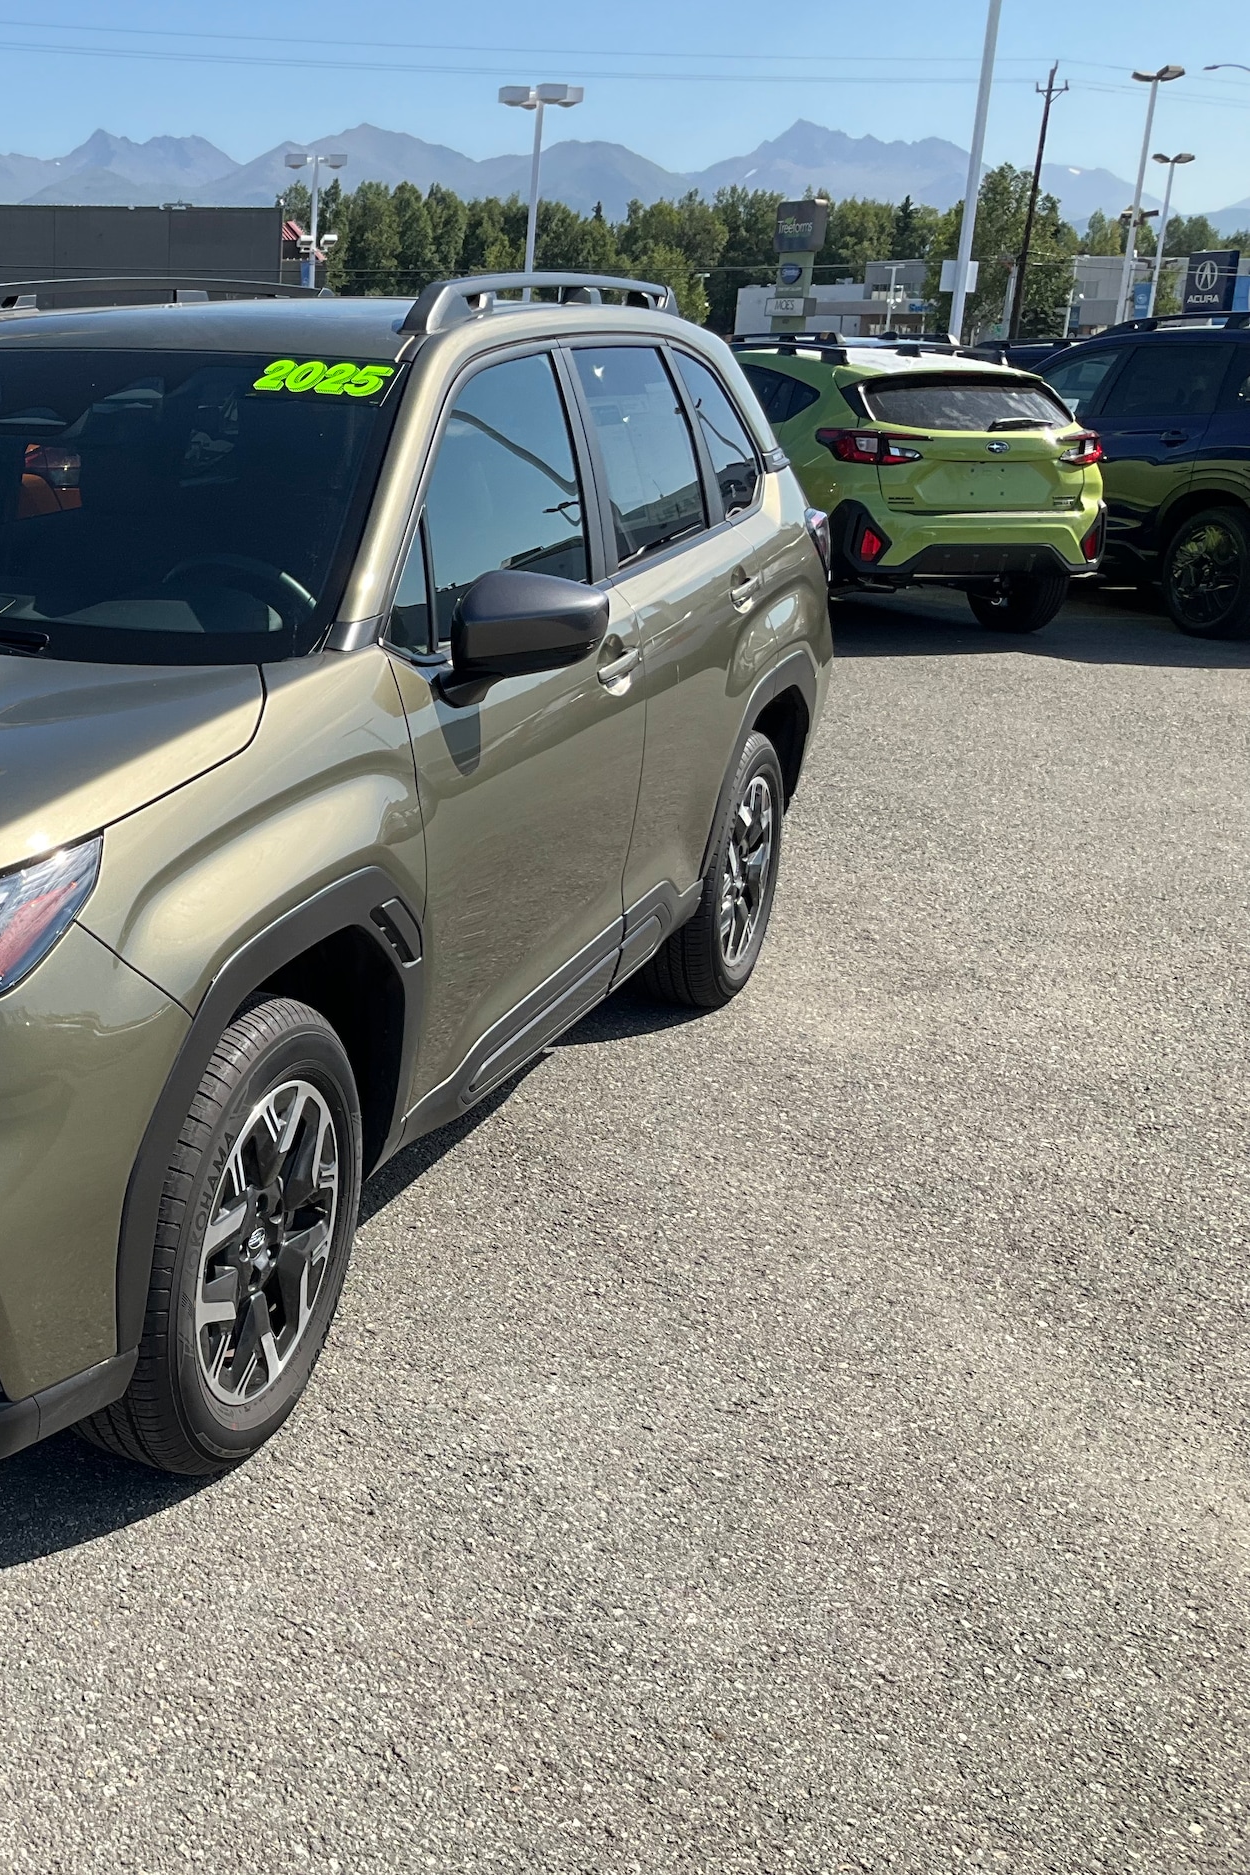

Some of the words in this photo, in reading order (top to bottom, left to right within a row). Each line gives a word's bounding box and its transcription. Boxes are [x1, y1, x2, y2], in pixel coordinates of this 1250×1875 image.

[778, 218, 813, 234] Treeforms
[1187, 294, 1220, 304] ACURA
[253, 360, 395, 397] 2025
